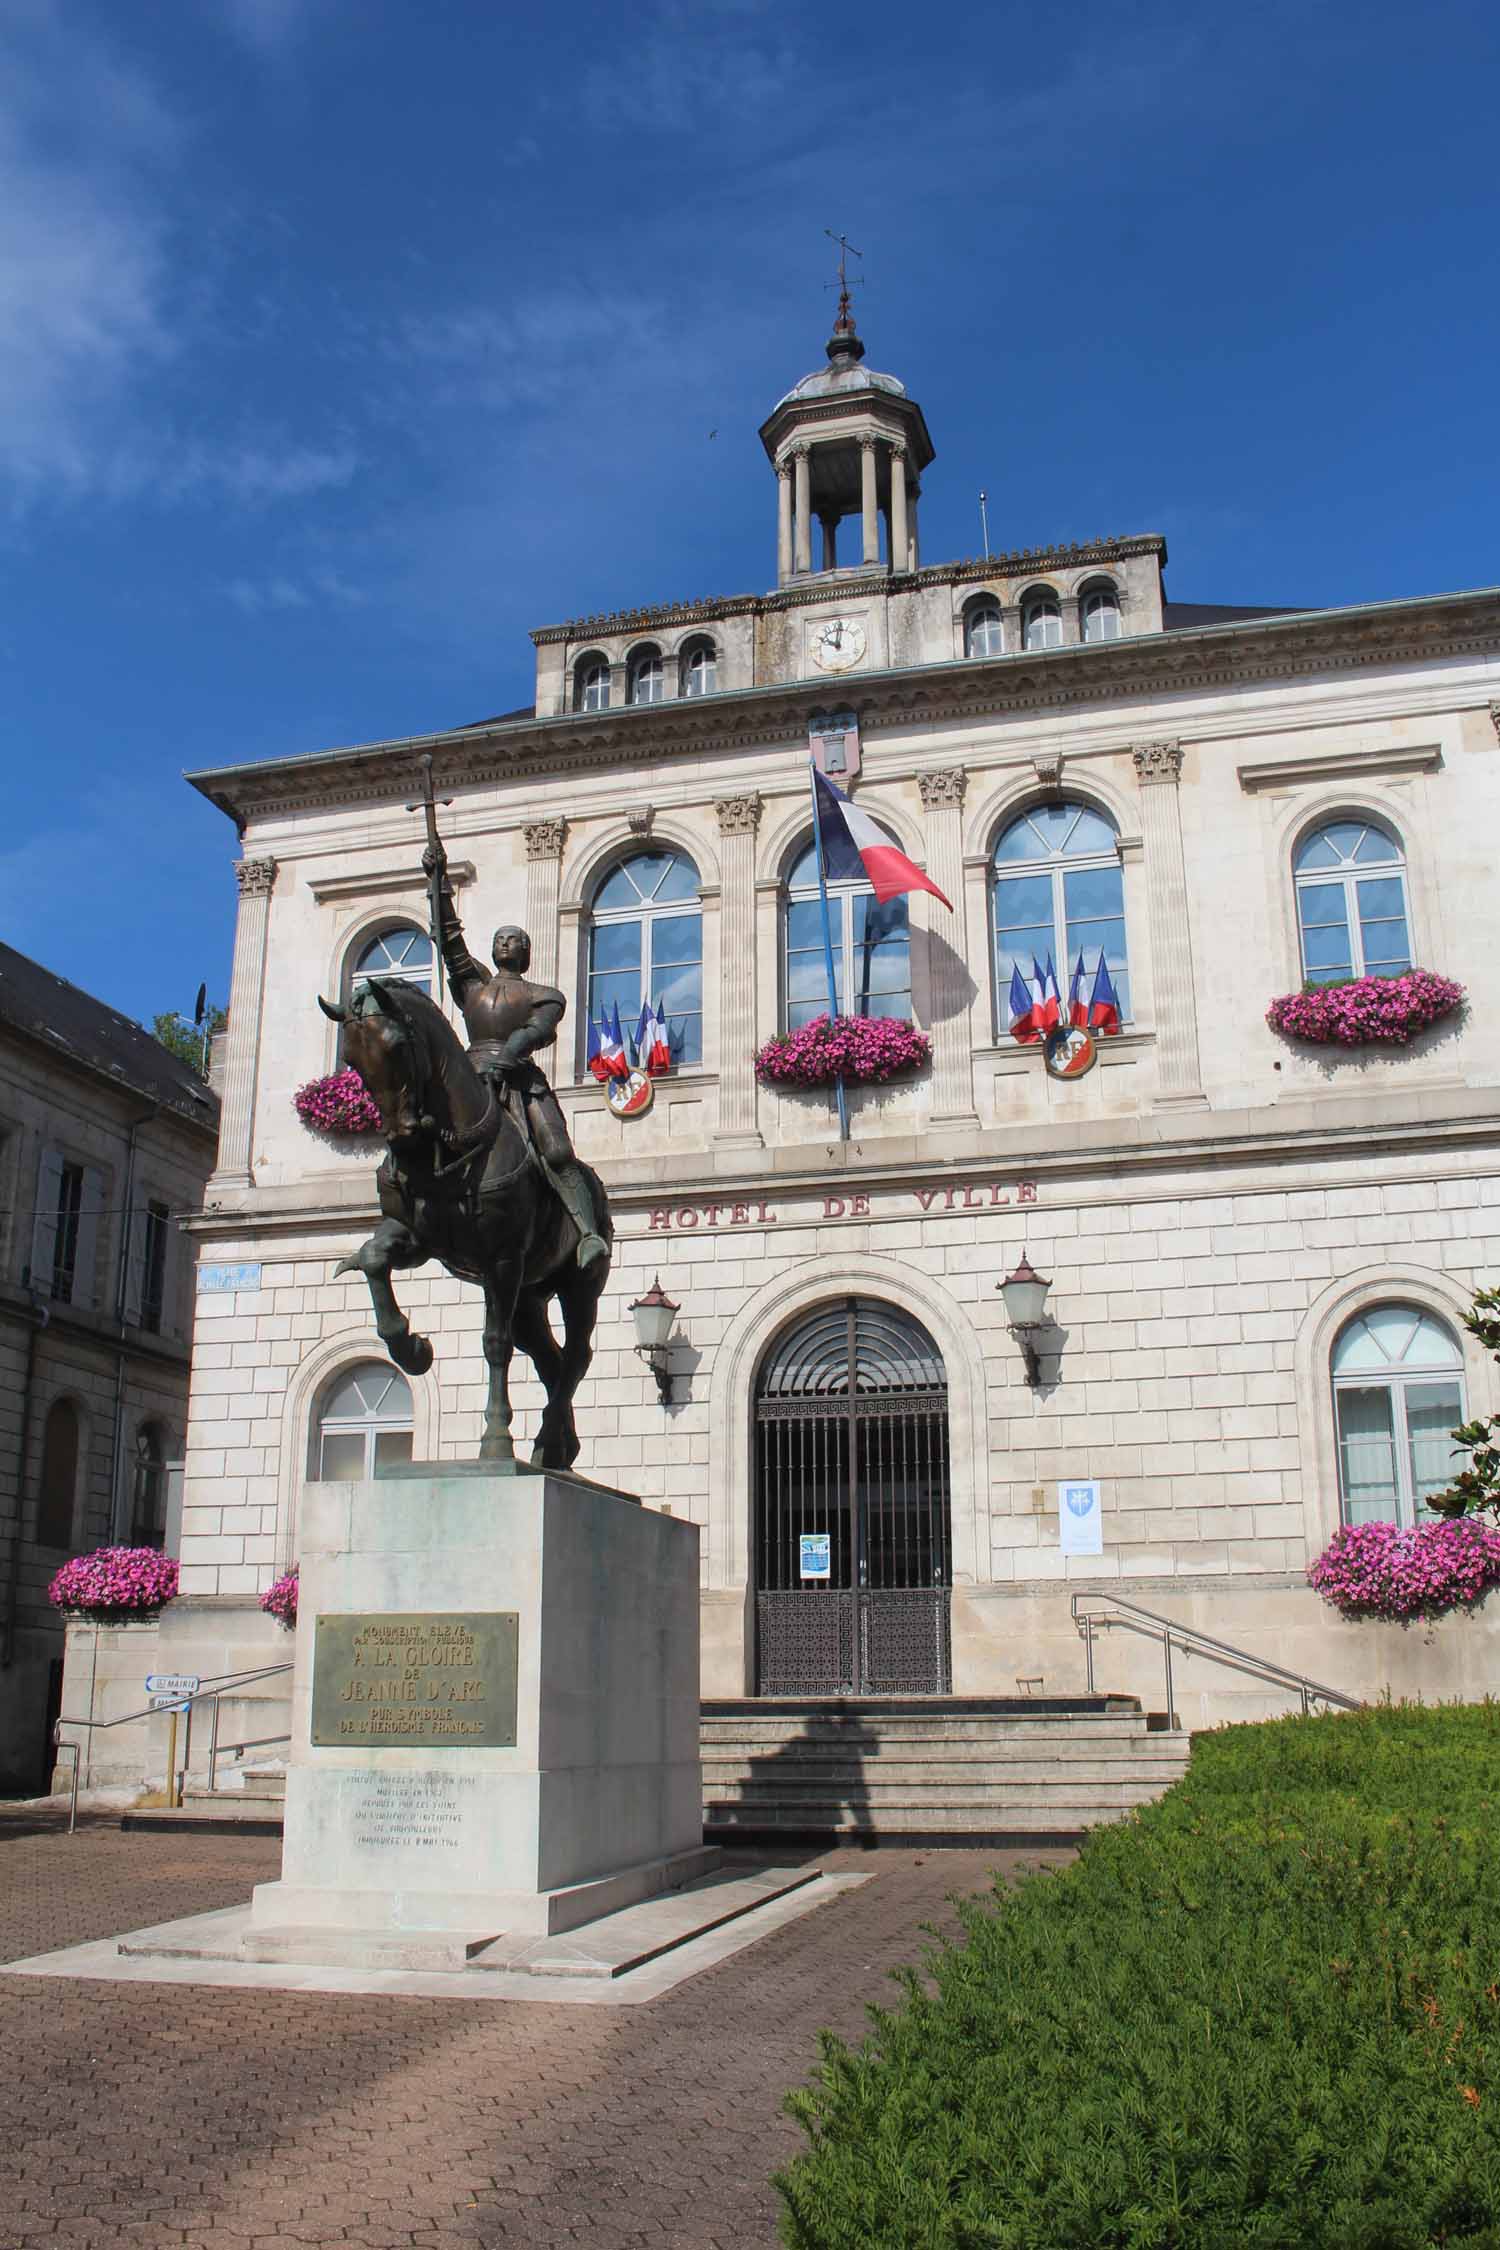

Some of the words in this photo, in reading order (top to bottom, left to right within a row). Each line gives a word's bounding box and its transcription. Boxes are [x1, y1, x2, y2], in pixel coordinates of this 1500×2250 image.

[648, 1200, 777, 1230] HOTEL
[823, 1193, 870, 1218] DE
[913, 1180, 1038, 1211] VILLE
[374, 1646, 397, 1667] LA
[405, 1645, 474, 1667] GLOIRE
[403, 1668, 422, 1681] DE
[168, 1679, 195, 1689] MAIRIE
[341, 1680, 417, 1702] JEANNE
[370, 1707, 393, 1721] PUR
[396, 1706, 454, 1721] SYMBOLE
[340, 1720, 355, 1734] DE
